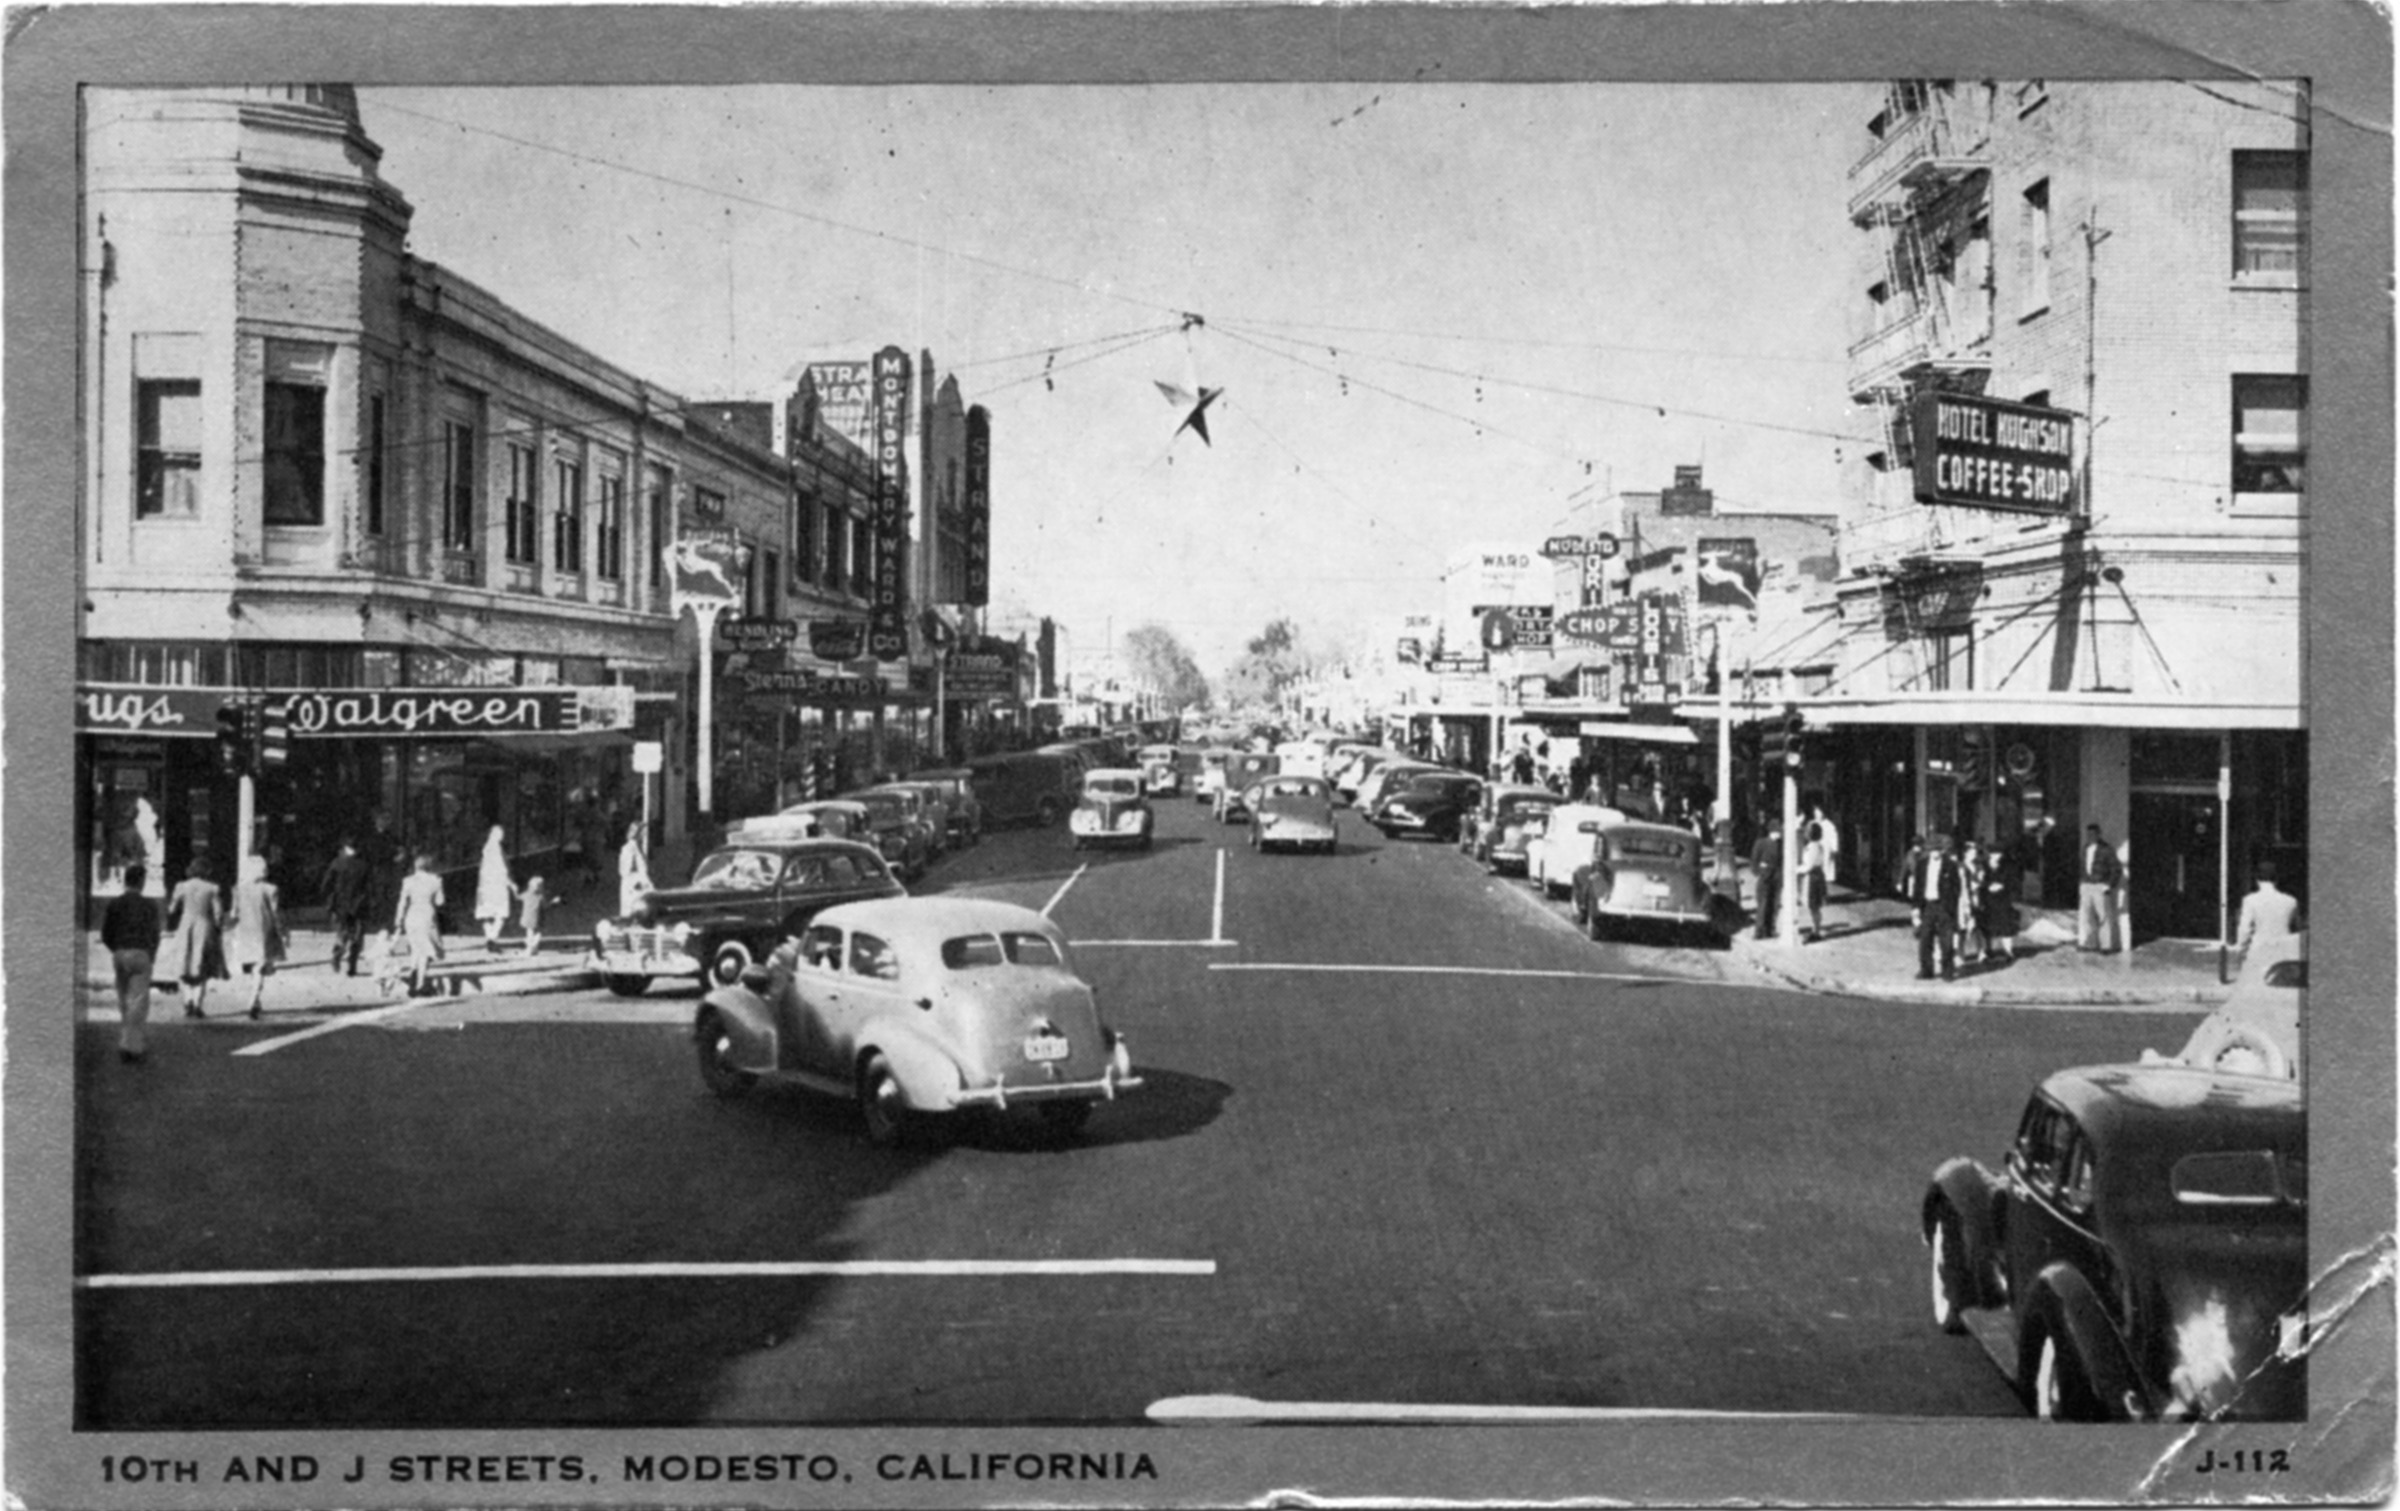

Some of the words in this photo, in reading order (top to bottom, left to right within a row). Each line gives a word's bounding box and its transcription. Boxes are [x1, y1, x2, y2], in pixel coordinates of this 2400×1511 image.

[1937, 403, 1991, 445] HOTEL
[970, 437, 987, 587] STRAND
[881, 538, 897, 604] WARD
[1482, 553, 1530, 568] WARD
[1567, 617, 1620, 633] CHOP
[286, 693, 541, 733] Walgreen
